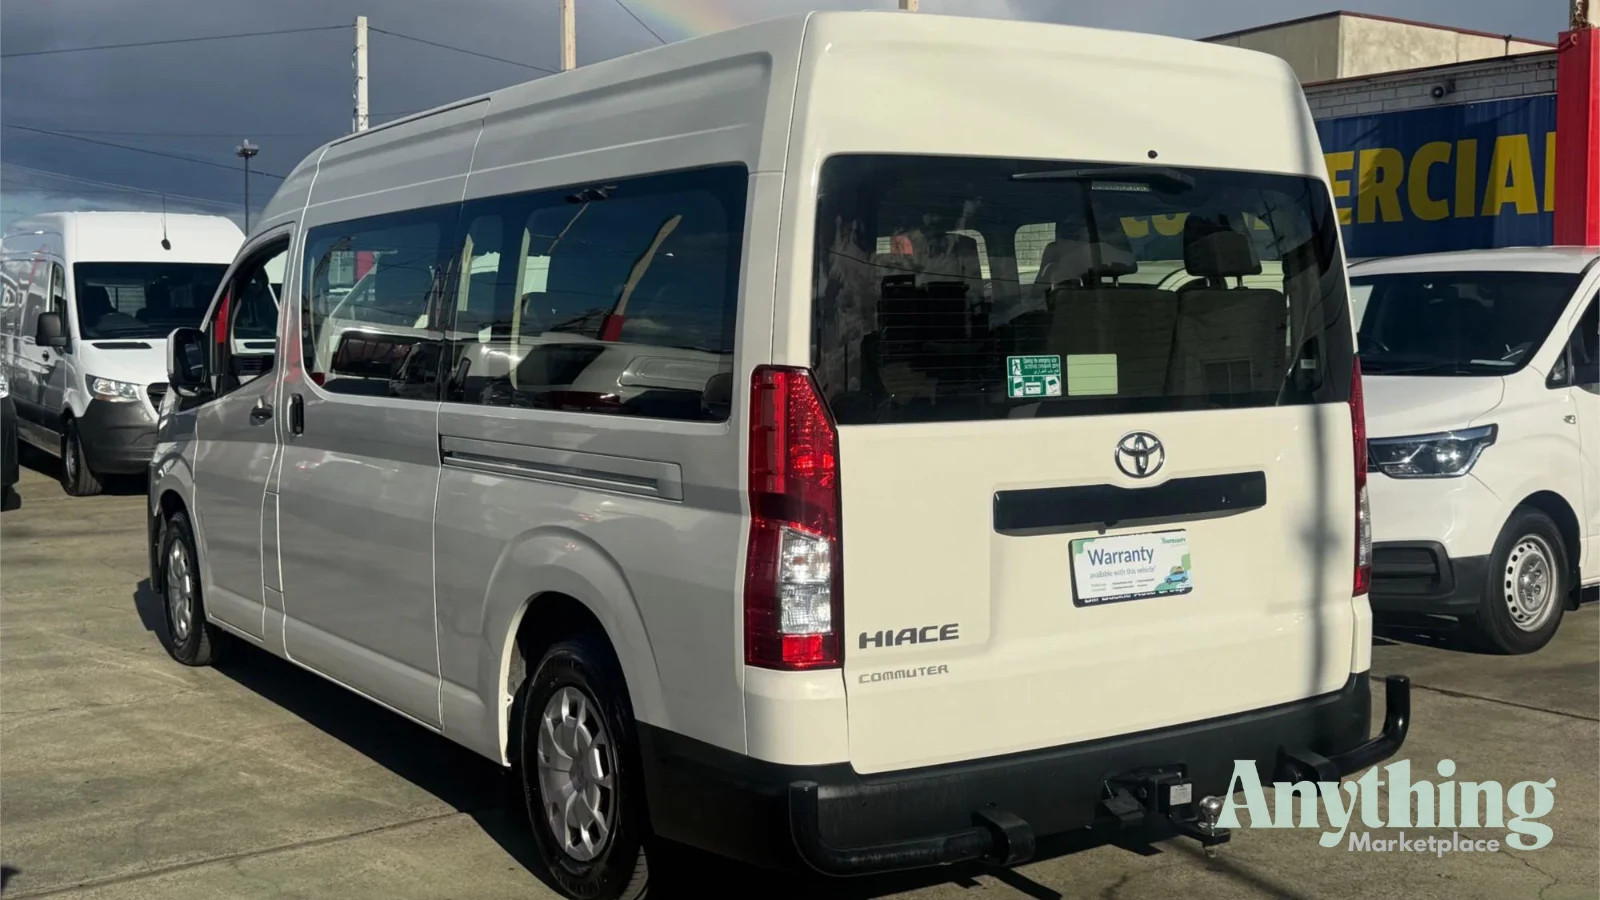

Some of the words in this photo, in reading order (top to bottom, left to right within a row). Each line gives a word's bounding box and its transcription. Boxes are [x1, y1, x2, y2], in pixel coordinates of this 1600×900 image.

[1088, 546, 1154, 566] Warranty
[1090, 570, 1113, 579] available
[858, 623, 959, 649] HIACE
[858, 664, 949, 684] COMMUTER
